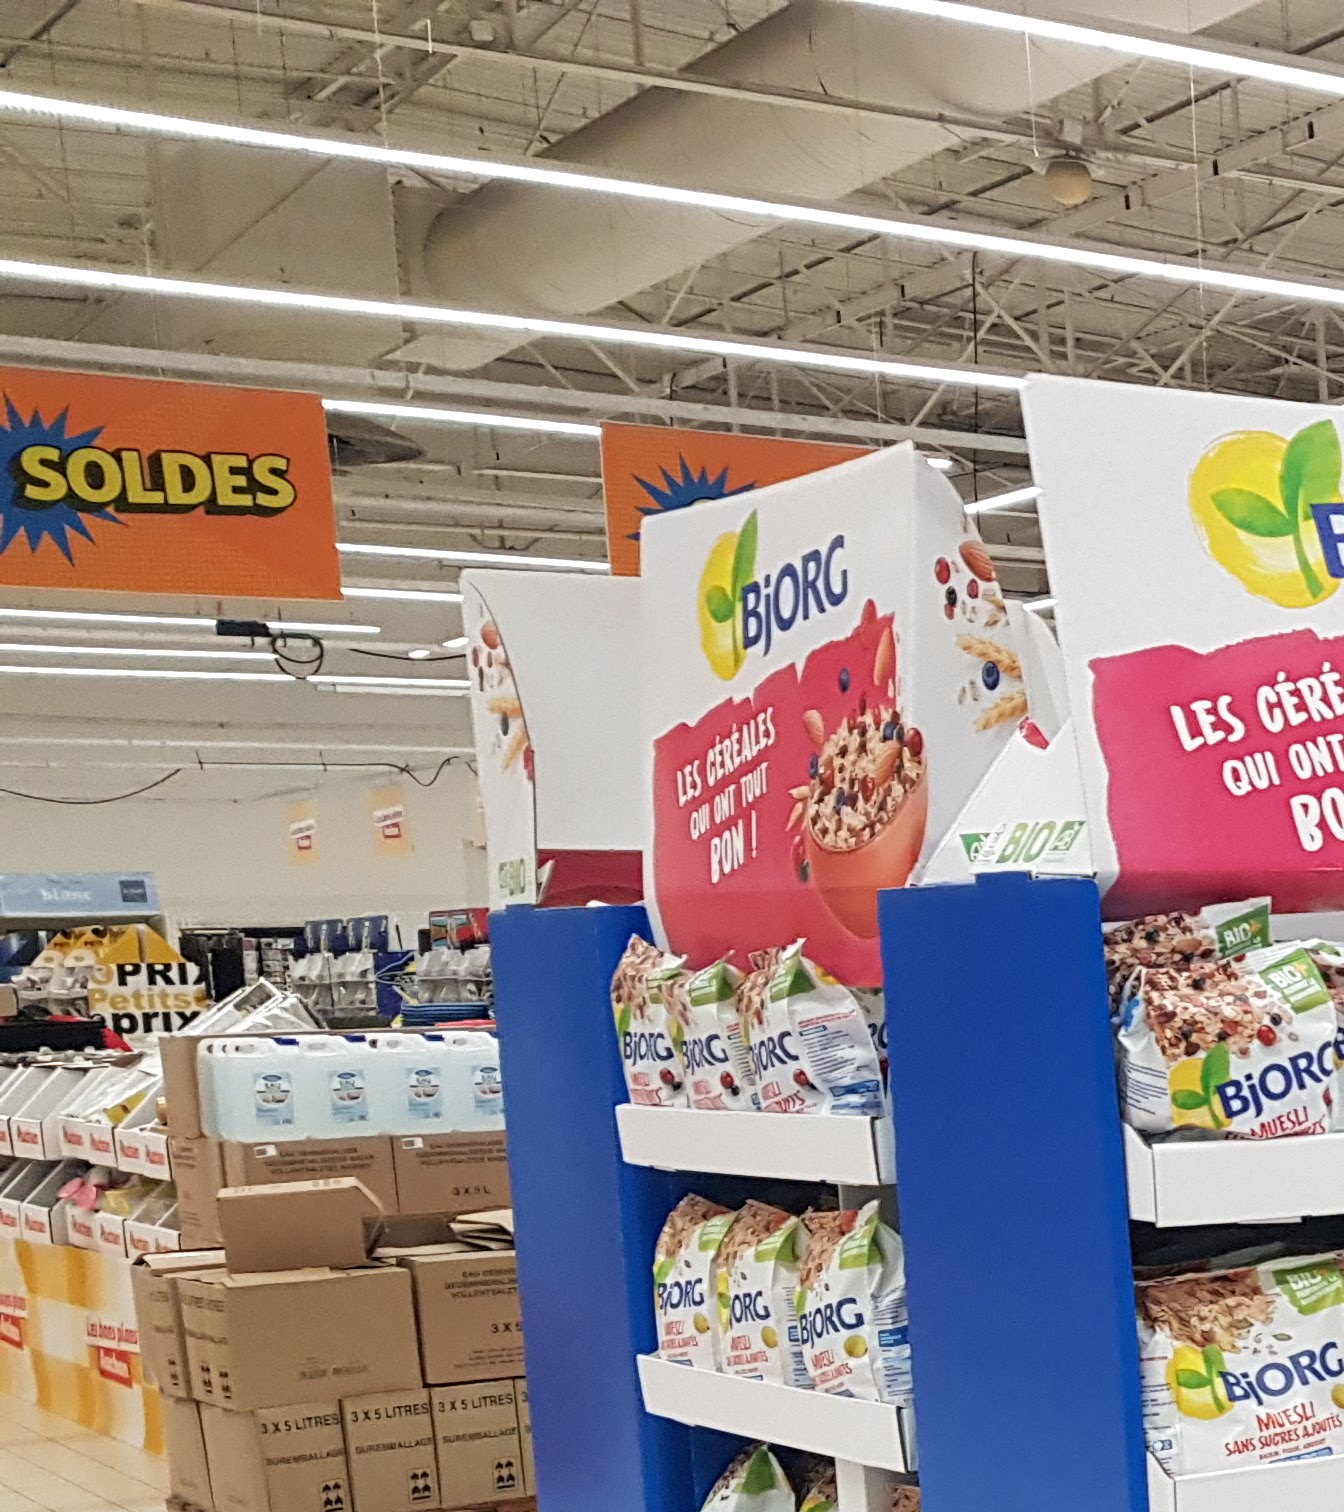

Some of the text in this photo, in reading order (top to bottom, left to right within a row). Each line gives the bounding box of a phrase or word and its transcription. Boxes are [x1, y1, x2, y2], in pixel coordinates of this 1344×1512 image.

[18, 443, 298, 513] SOLDES
[1170, 698, 1245, 754] LES
[677, 707, 776, 806] LES CÉRÉALES
[1222, 748, 1279, 798] QUI
[690, 761, 768, 839] QUI ONT TOUT
[710, 824, 745, 884] BON
[295, 1412, 340, 1432] LITRES
[386, 1402, 429, 1420] LITRES
[474, 1393, 514, 1410] LITRES
[1256, 1401, 1315, 1432] MUESLI
[1225, 1438, 1256, 1456] SANS
[1259, 1428, 1300, 1449] SUCRES
